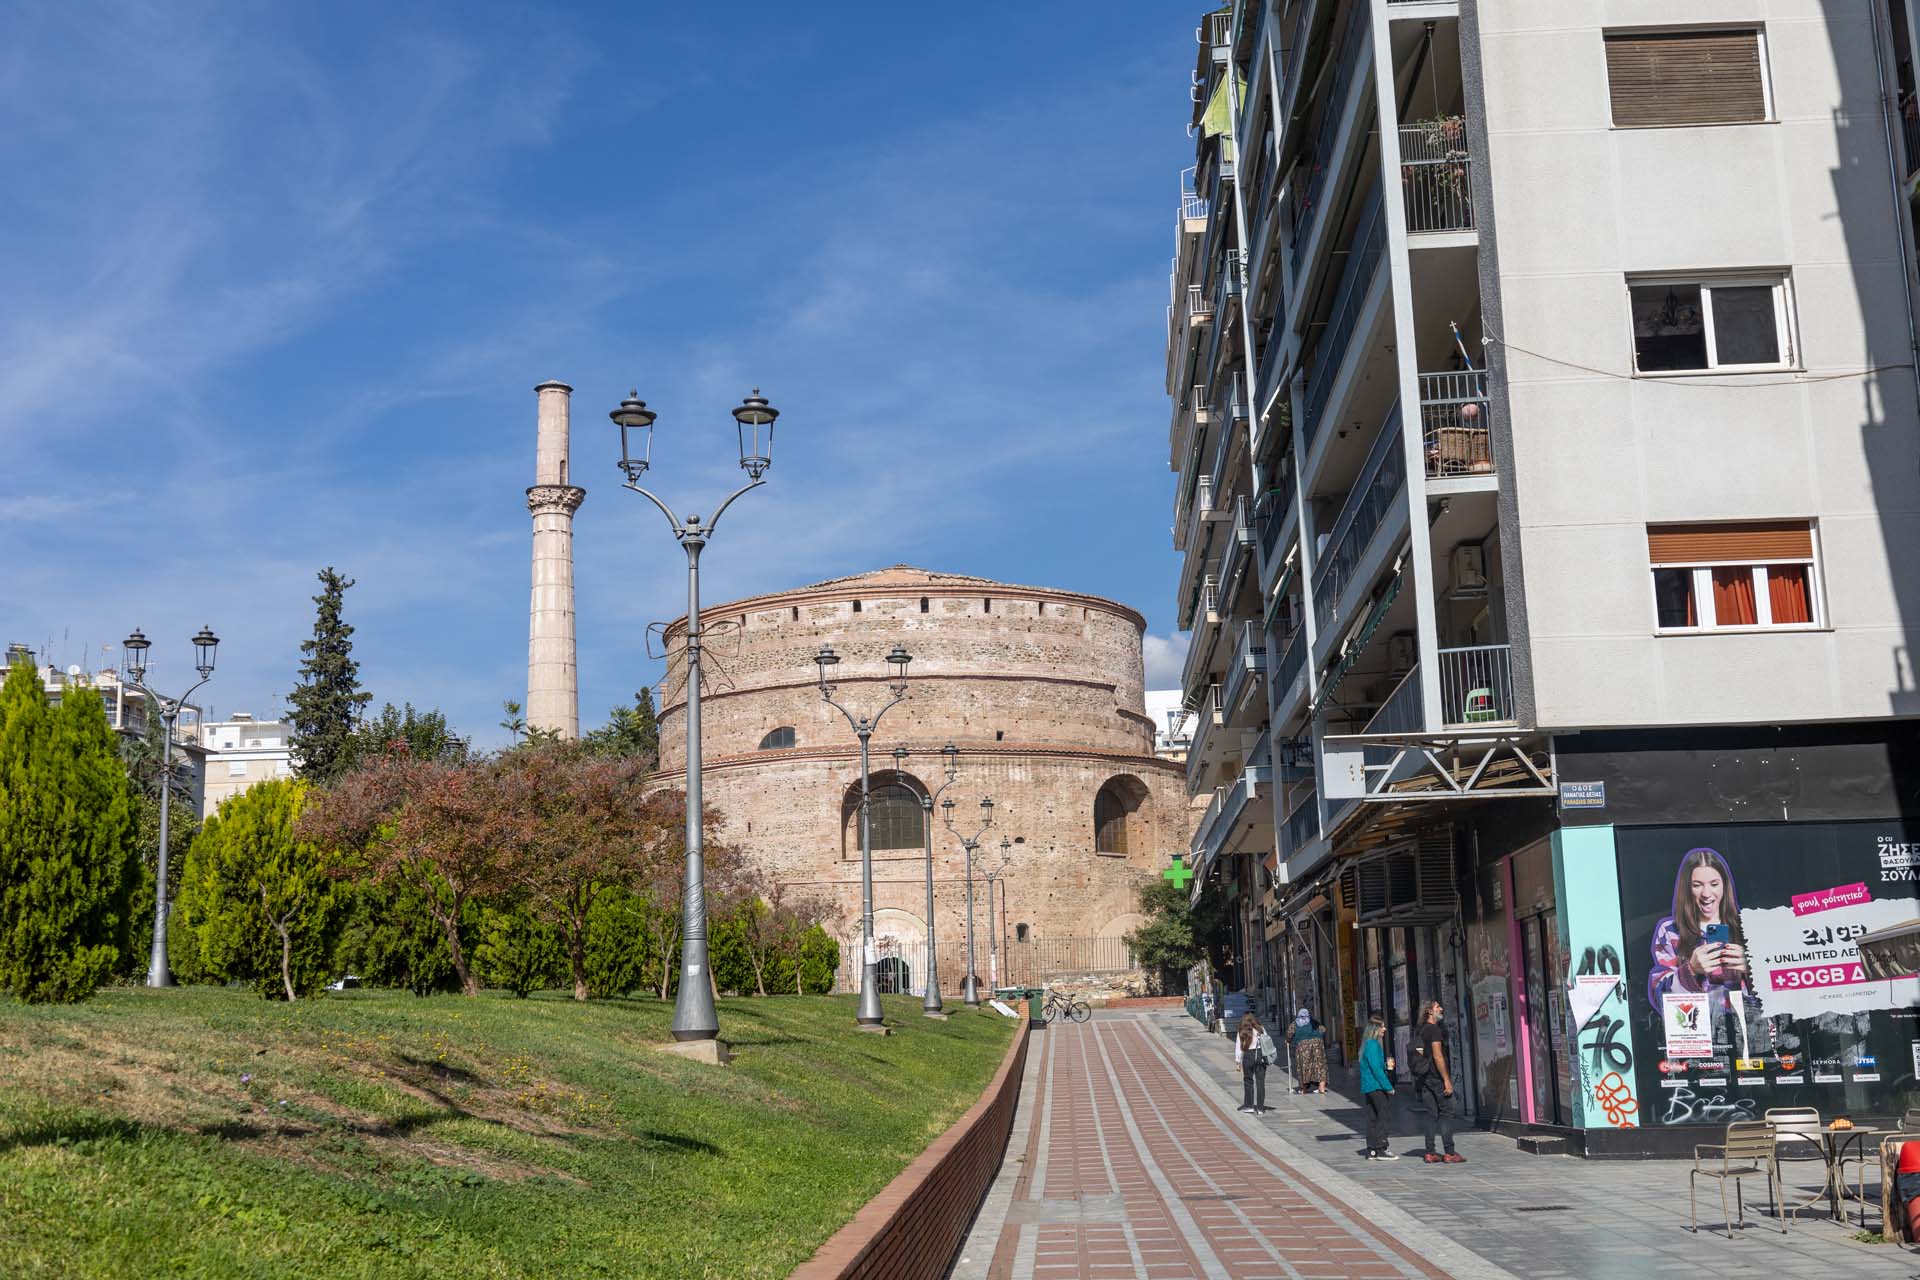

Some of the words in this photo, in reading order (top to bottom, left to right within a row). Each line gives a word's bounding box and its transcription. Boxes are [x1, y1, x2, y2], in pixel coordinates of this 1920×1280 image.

[1880, 870, 1920, 881] ΣΟΥΛ
[1797, 896, 1820, 912] φουλ
[1821, 887, 1863, 907] φοιτητικό
[1774, 950, 1838, 964] UNLIMITED
[1775, 967, 1845, 987] +30GB
